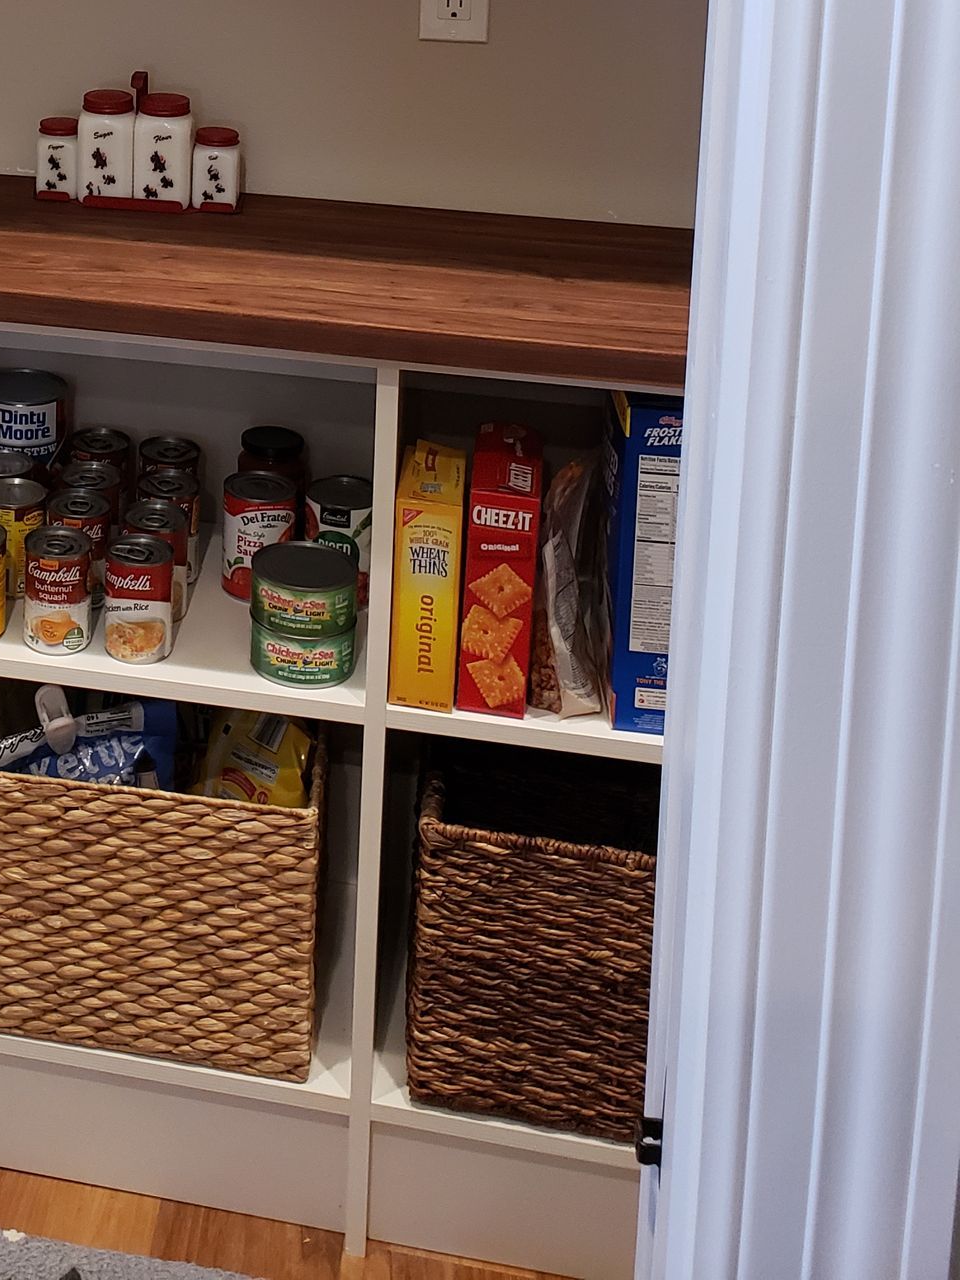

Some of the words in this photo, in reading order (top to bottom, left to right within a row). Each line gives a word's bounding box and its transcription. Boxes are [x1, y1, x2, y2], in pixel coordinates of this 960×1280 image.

[93, 131, 114, 140] Sugar
[153, 134, 172, 144] Flour
[0, 408, 47, 427] Dinty
[240, 513, 260, 526] Del
[237, 535, 264, 548] Pizza
[408, 546, 450, 562] WHEAT
[409, 558, 449, 578] THINS
[34, 580, 73, 593] butternut
[38, 591, 68, 601] squash
[133, 602, 150, 612] Rice
[268, 602, 289, 612] CHUNK
[305, 609, 325, 617] LIGHT
[415, 594, 438, 674] original
[266, 642, 304, 660] Chicken
[275, 656, 298, 665] CHUNK
